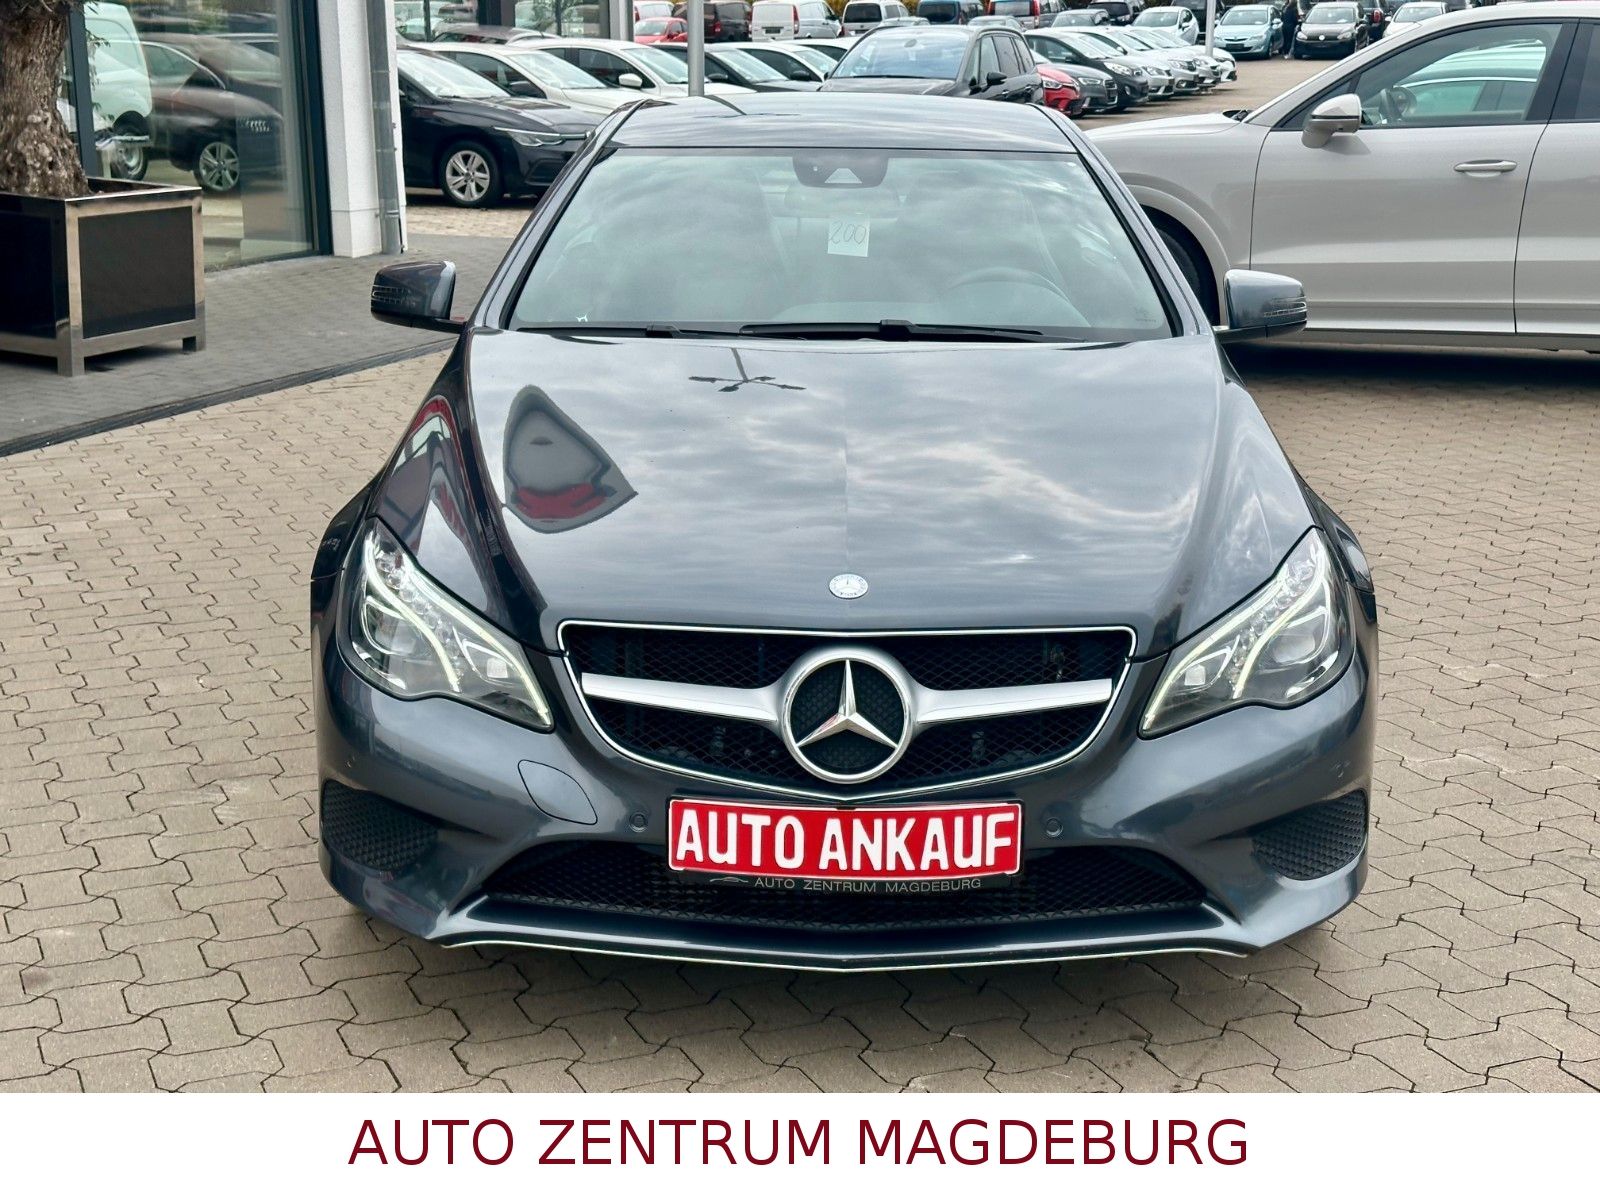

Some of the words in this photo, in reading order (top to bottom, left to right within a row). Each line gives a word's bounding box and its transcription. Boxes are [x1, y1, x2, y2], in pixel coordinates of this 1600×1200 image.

[831, 219, 867, 245] 200
[676, 809, 805, 869] AUTO
[818, 812, 1015, 871] ANKAUF
[754, 877, 796, 889] AUTO
[803, 879, 877, 893] ZENTRUM
[885, 878, 982, 893] MAGDEBURG
